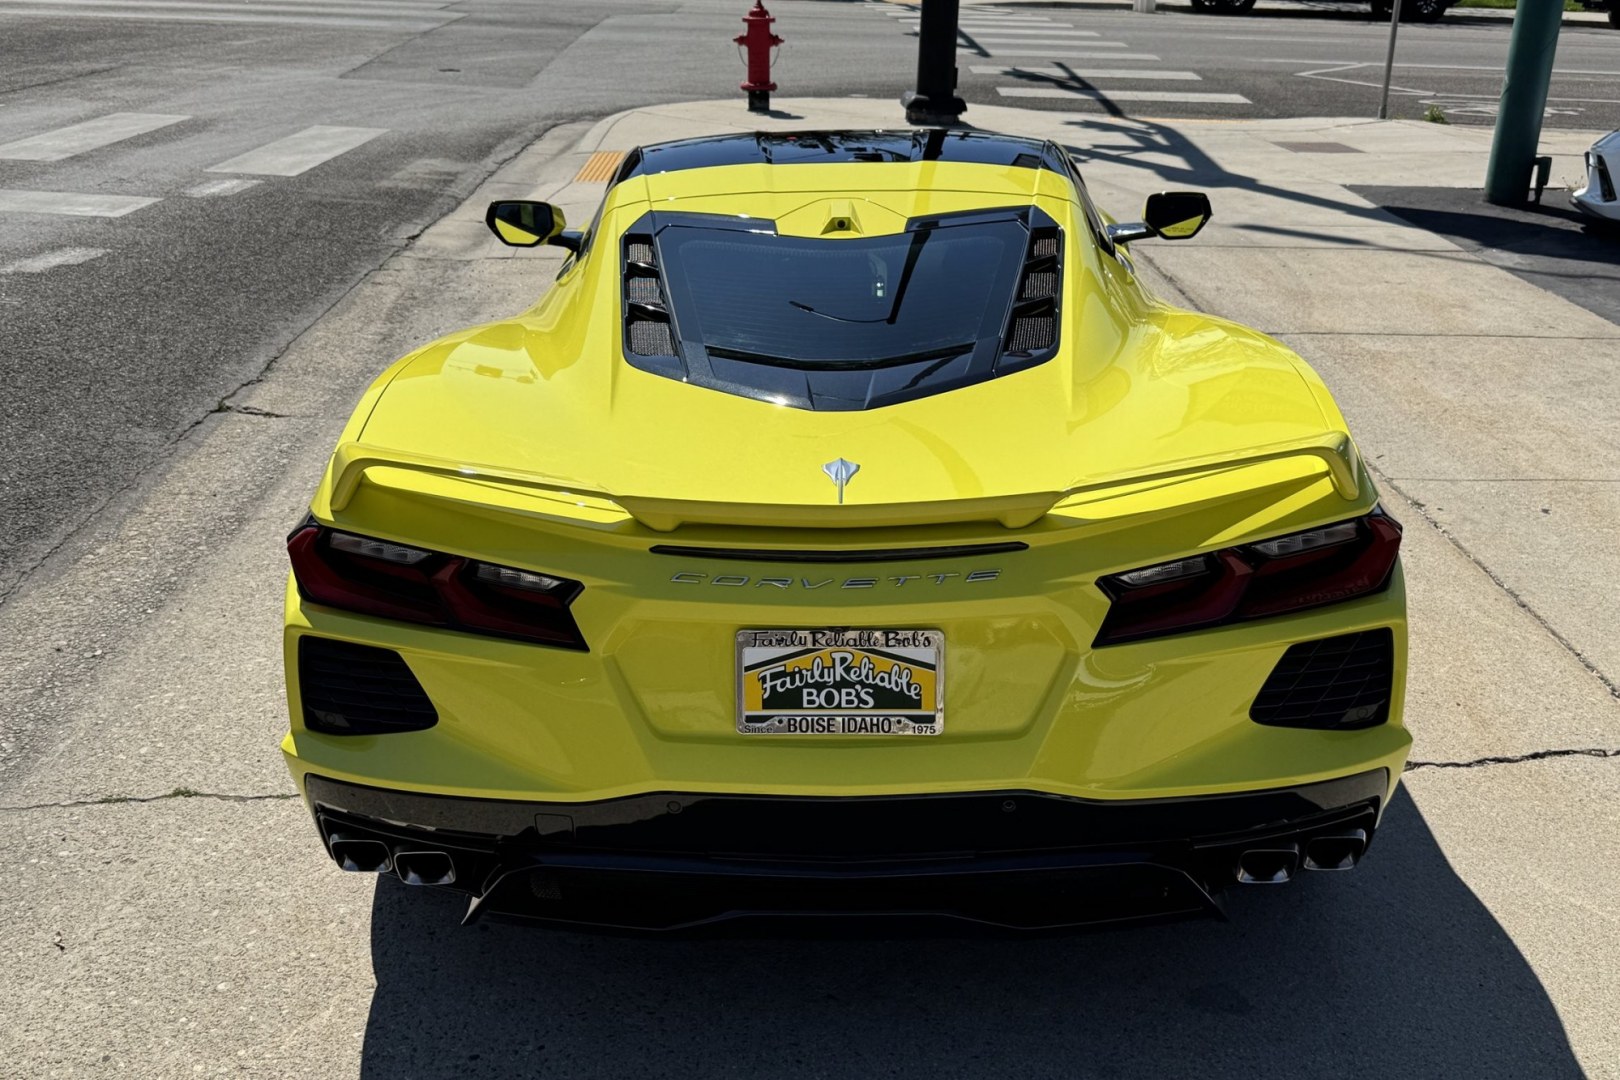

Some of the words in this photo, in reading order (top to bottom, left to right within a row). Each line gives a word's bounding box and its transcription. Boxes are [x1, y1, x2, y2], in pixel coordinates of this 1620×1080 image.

[670, 569, 1002, 590] CORVETTE
[751, 630, 807, 648] Fairly
[810, 631, 879, 648] Reliable
[883, 631, 931, 648] Bob's
[802, 684, 875, 709] BOB'S
[744, 725, 773, 734] Since
[787, 717, 836, 733] BOISE
[841, 717, 892, 733] IDAHO
[912, 725, 936, 734] 1975
